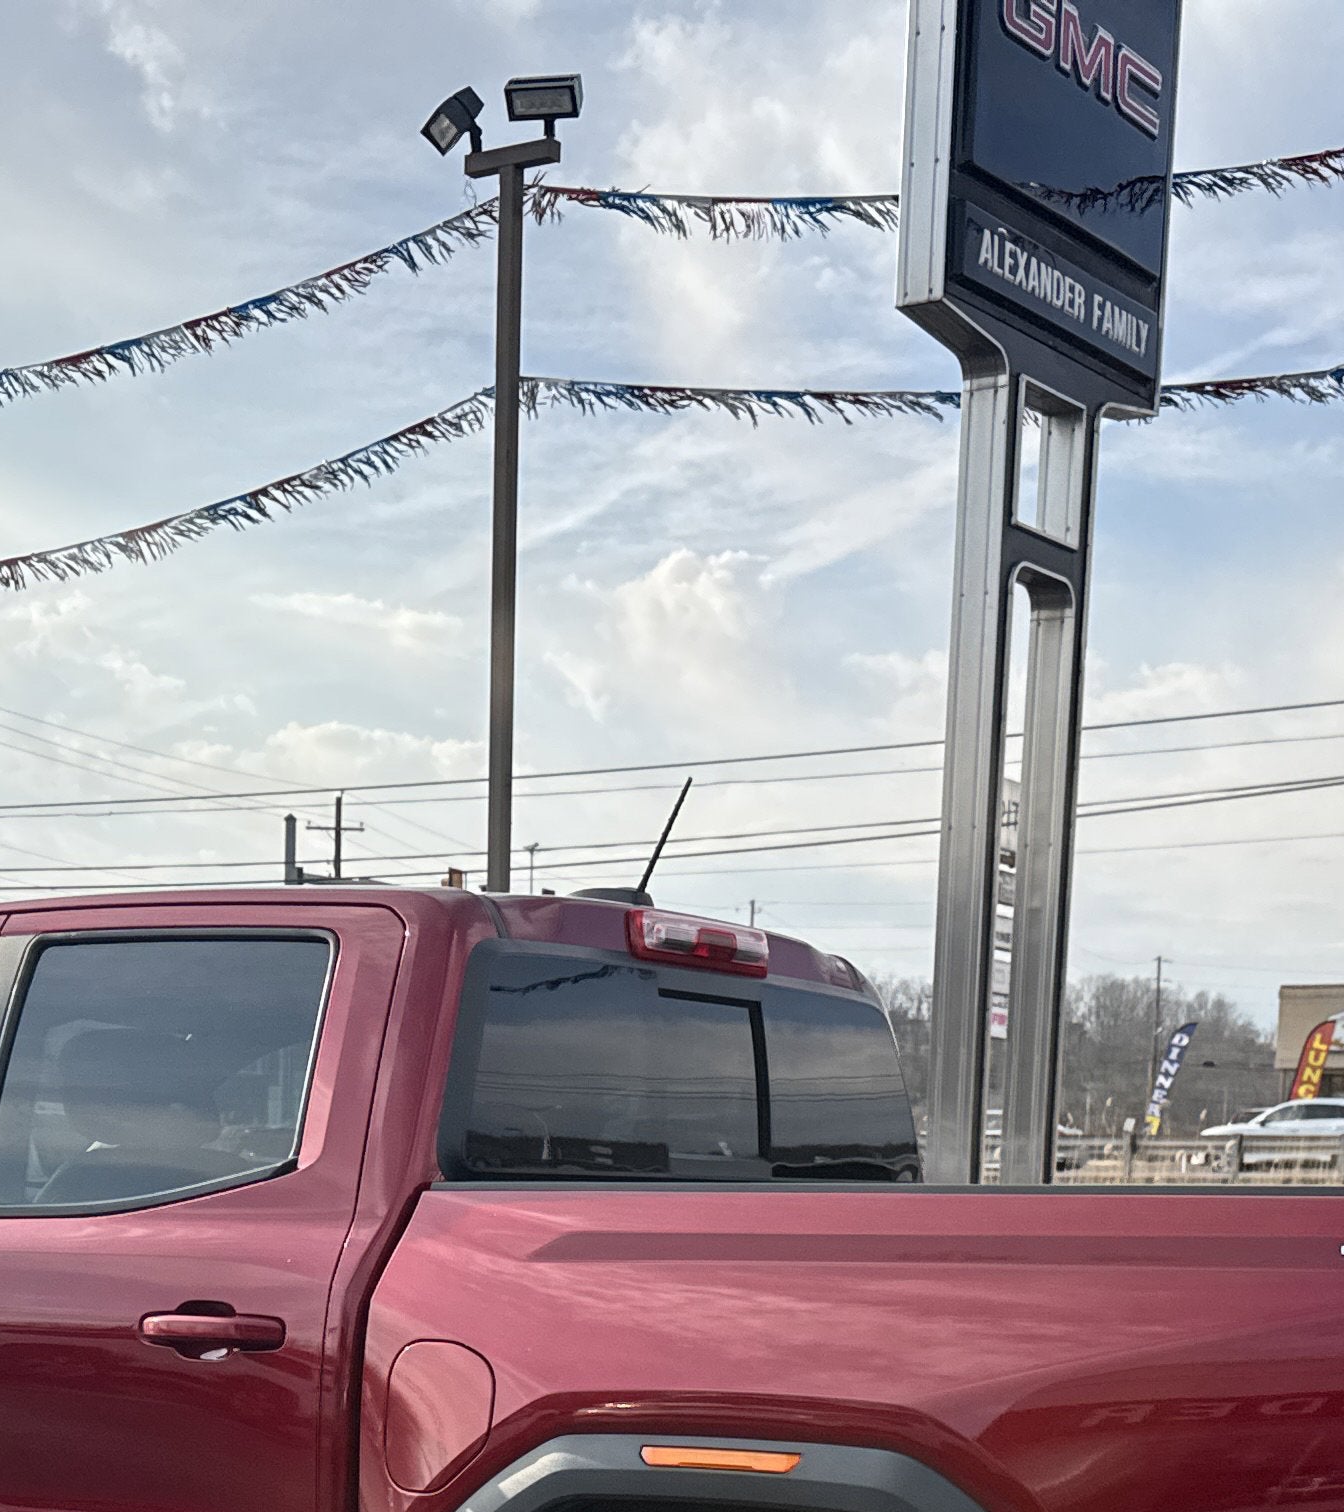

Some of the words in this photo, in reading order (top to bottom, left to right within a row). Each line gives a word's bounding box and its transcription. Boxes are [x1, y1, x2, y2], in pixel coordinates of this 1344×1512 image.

[1001, 0, 1163, 141] GMC
[978, 227, 1086, 324] ALEXANDER
[1091, 292, 1150, 358] FAMILY
[1297, 1033, 1328, 1100] LUNC
